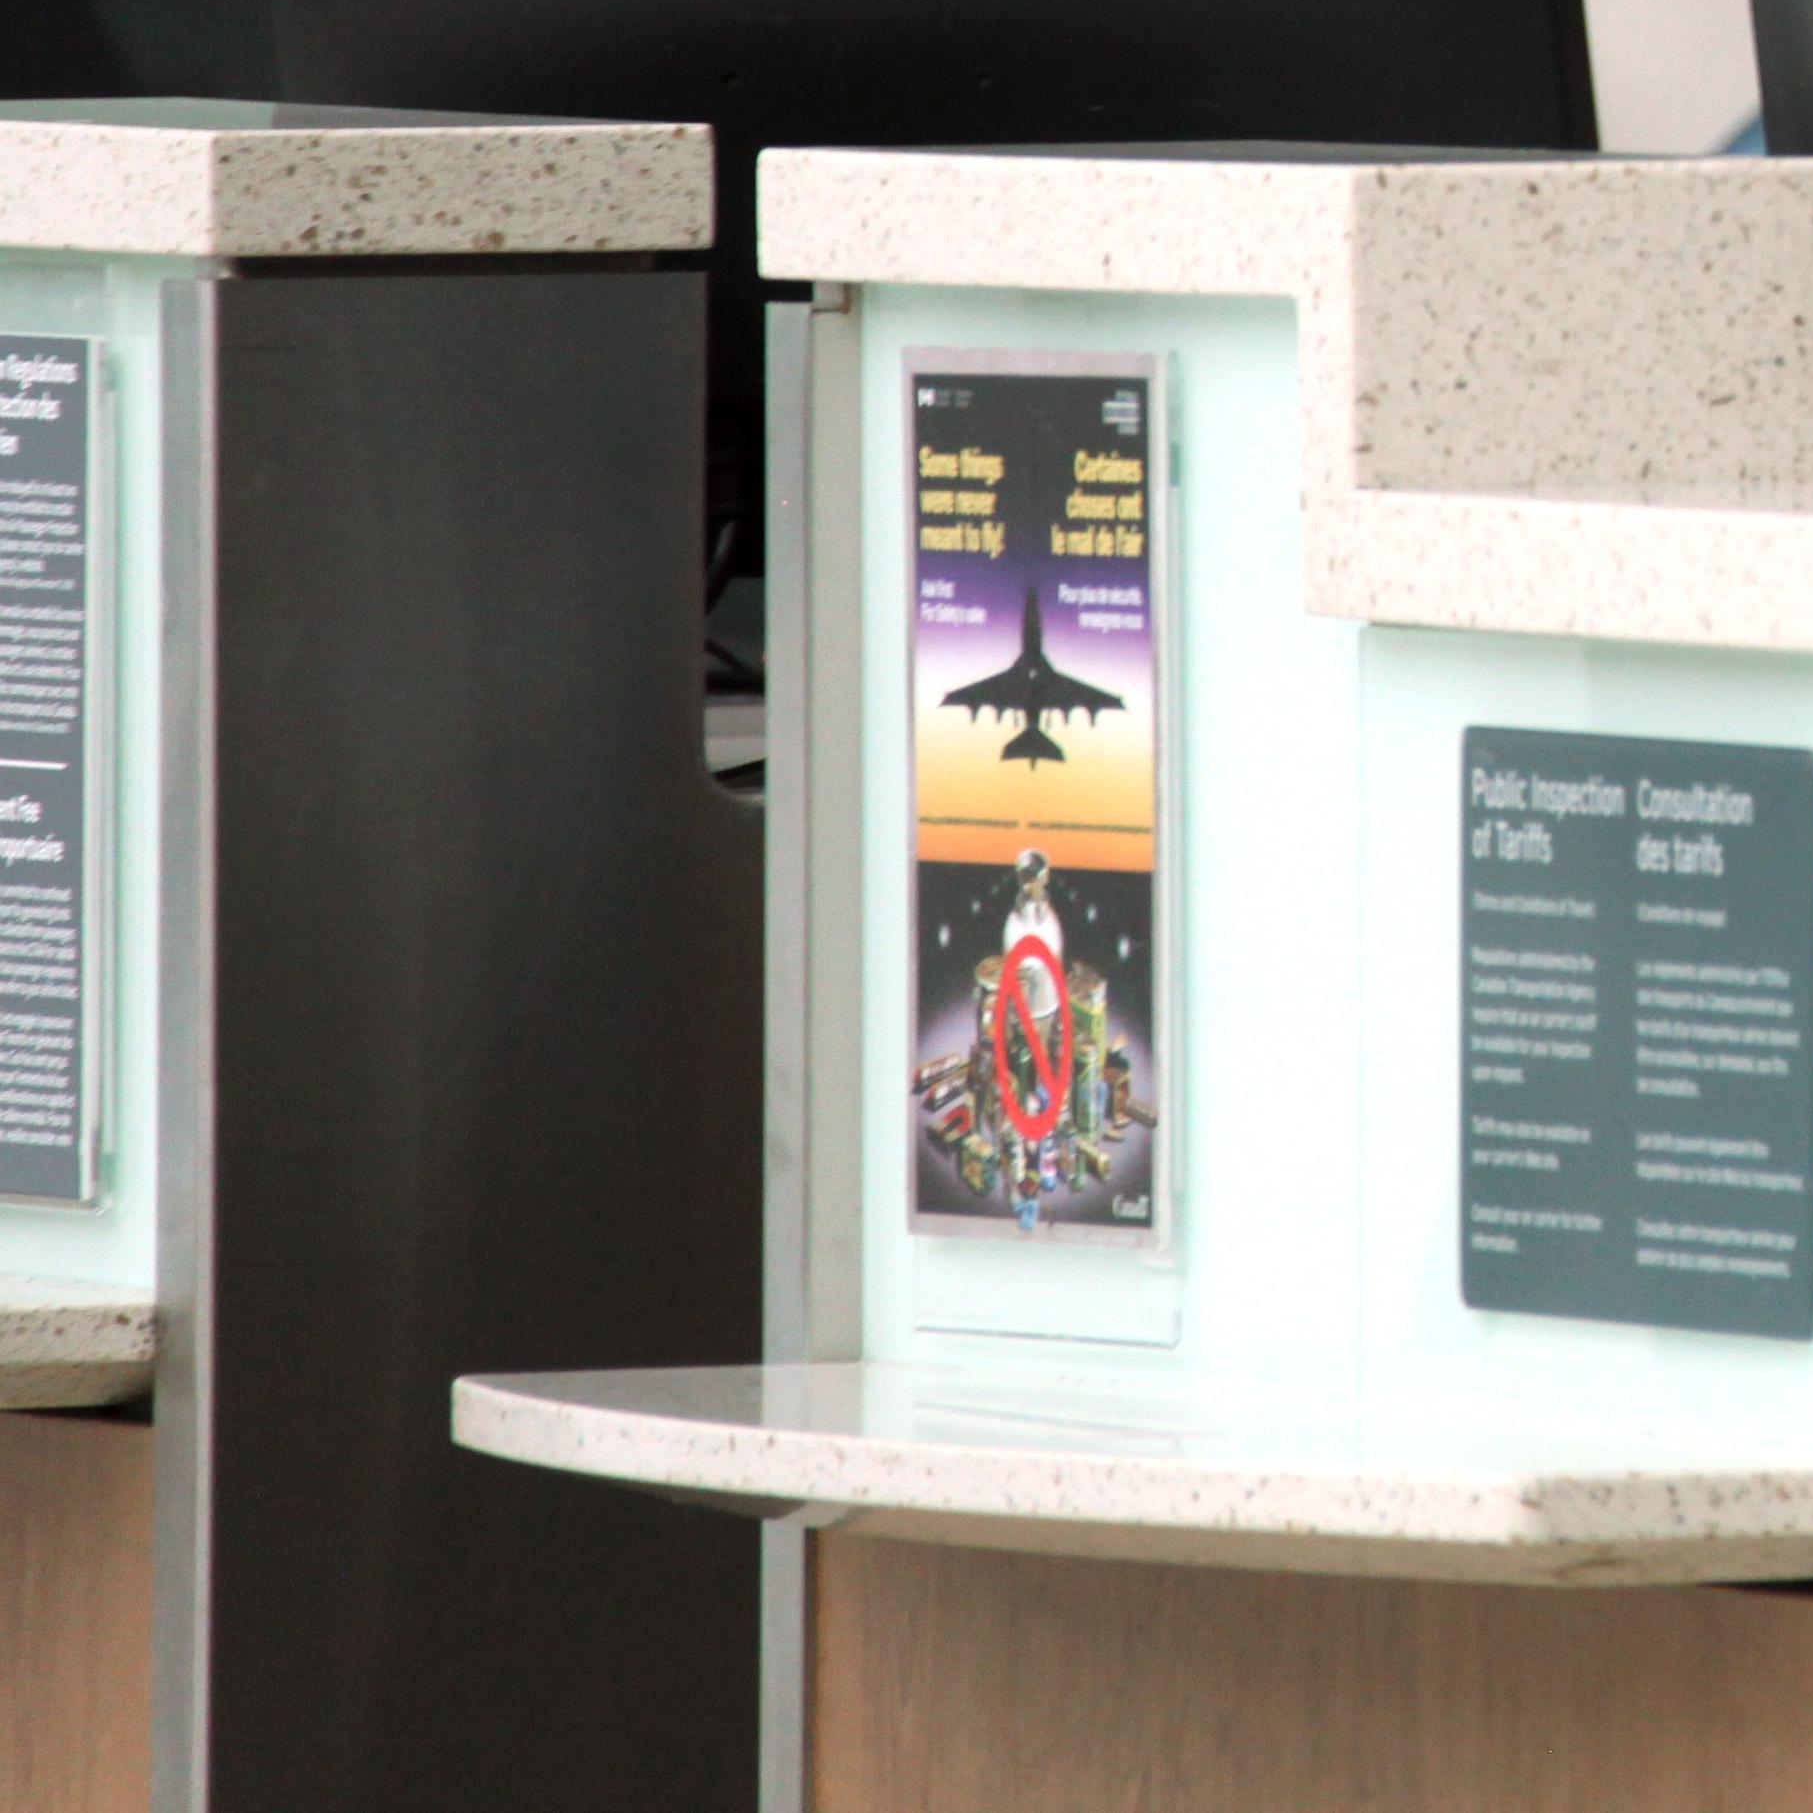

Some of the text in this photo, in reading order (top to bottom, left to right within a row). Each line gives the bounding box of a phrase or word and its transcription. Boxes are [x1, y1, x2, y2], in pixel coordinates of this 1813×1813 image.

[919, 445, 1004, 485] Some things
[1074, 449, 1143, 483] Certaines
[920, 490, 997, 515] were never
[920, 523, 964, 551] meant
[1472, 766, 1625, 822] Public Inspection
[1637, 777, 1754, 826] Consultation
[1472, 819, 1553, 864] of Tariffs
[1637, 833, 1725, 878] des tarifs
